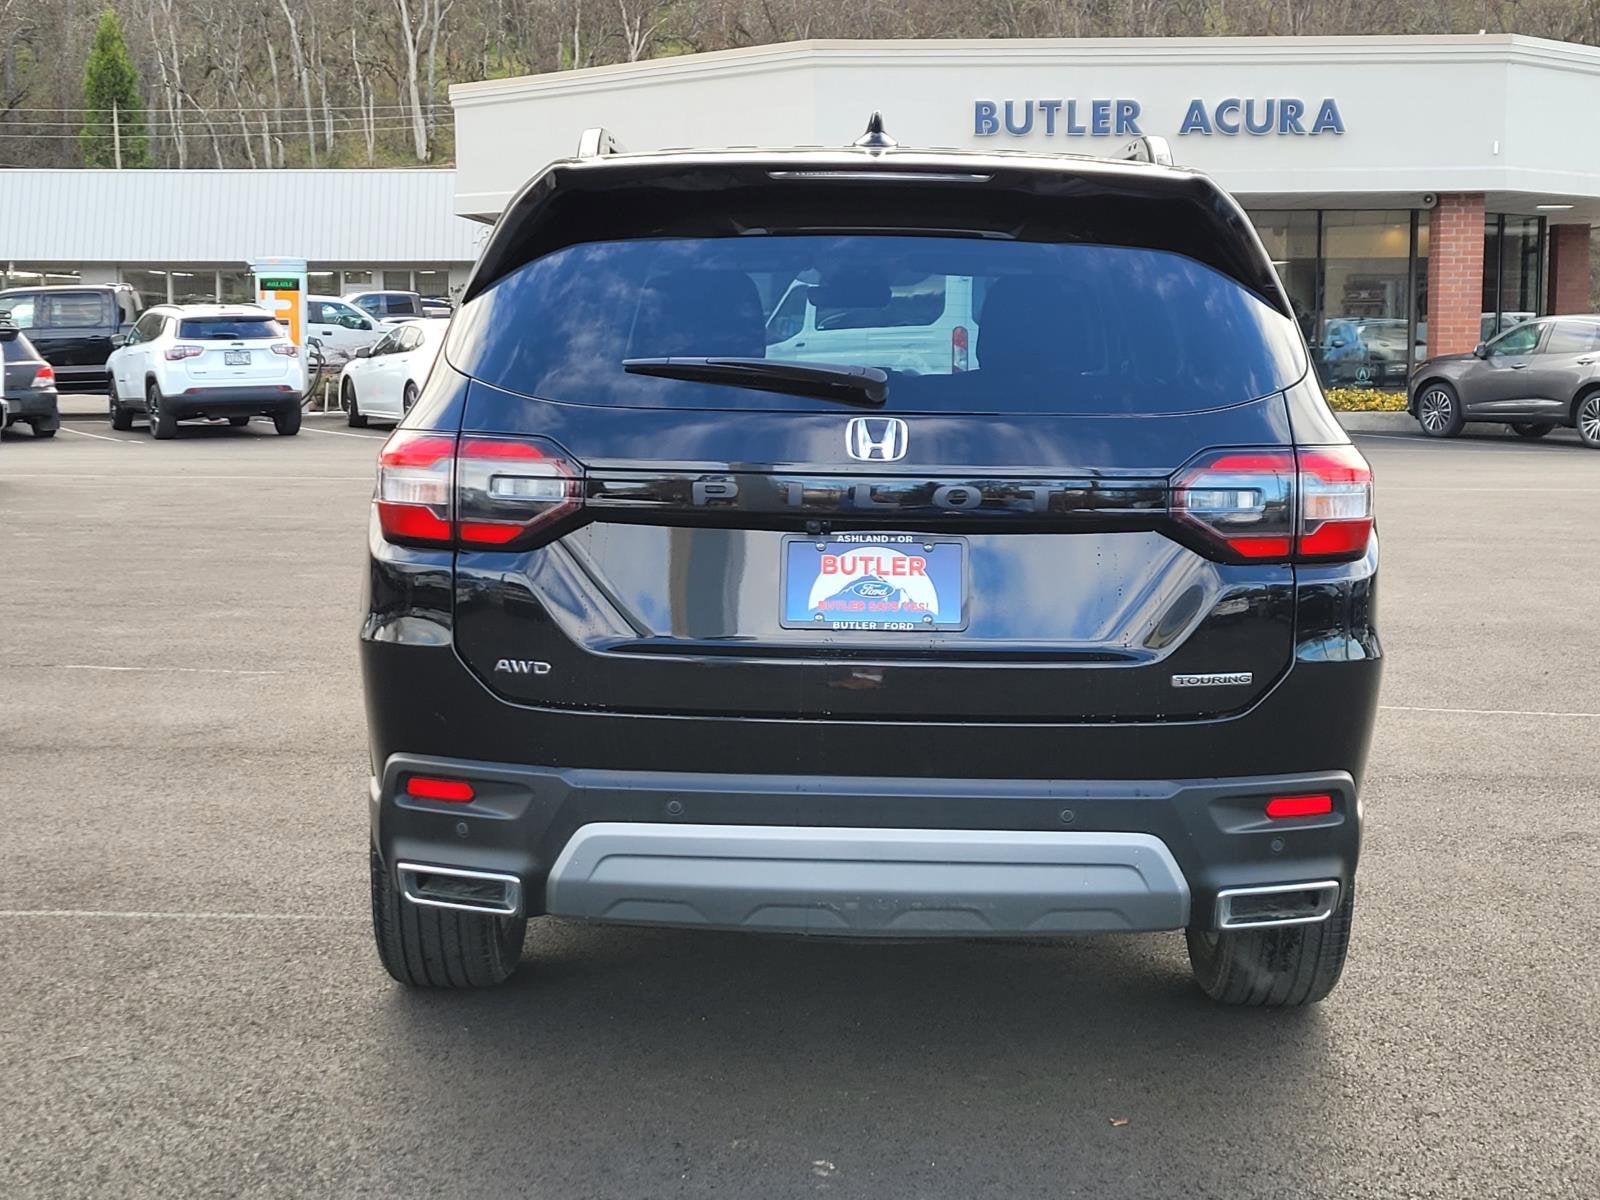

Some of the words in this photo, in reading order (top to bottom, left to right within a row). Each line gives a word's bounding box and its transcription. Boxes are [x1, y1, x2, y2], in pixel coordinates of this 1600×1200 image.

[974, 99, 1142, 137] BUTLER
[1178, 97, 1346, 136] ACURA
[691, 480, 1052, 513] PILOT
[837, 534, 889, 543] ASHLAND
[897, 535, 913, 543] OR
[820, 554, 926, 577] BUTLER
[859, 583, 888, 597] Ford
[818, 600, 864, 611] BUTLER
[832, 621, 877, 630] BUTLER
[884, 622, 914, 630] FORD
[494, 659, 552, 674] AWD
[1174, 674, 1251, 686] TOURING
